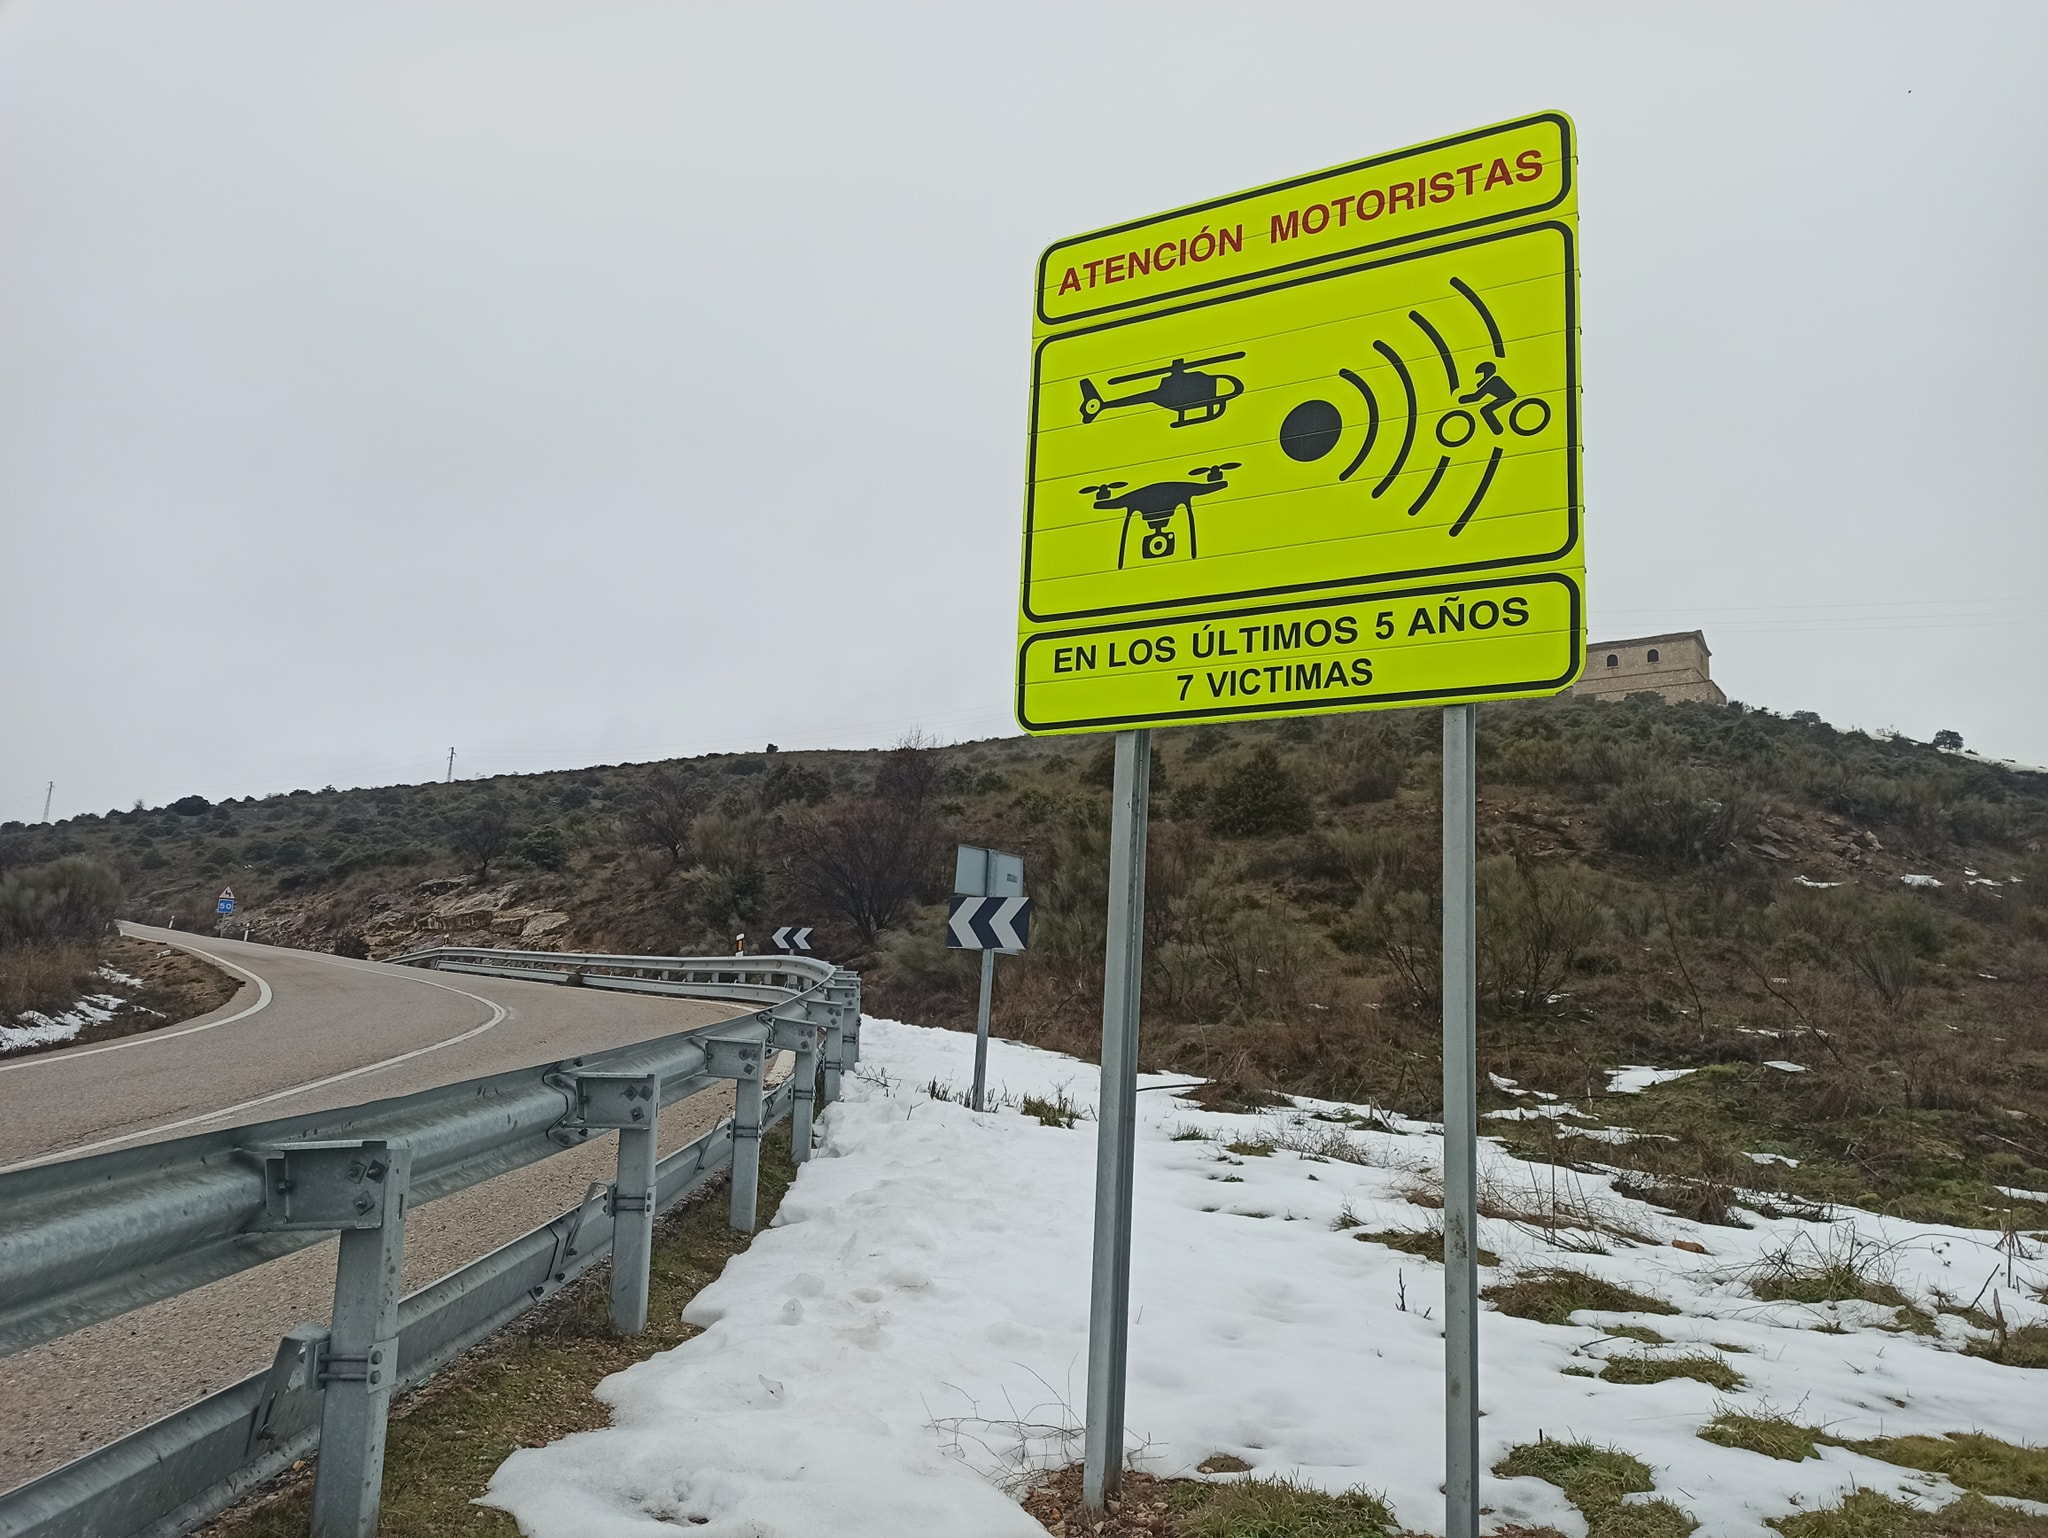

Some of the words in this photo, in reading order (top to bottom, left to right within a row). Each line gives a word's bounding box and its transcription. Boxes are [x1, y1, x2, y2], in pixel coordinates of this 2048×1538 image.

[1058, 224, 1243, 296] ATENCIÓN
[1270, 150, 1544, 244] MOTORISTAS
[1053, 644, 1097, 674] EN
[1109, 636, 1176, 667] LOS
[1192, 615, 1358, 658] ÚLTIMOS
[1375, 611, 1394, 640] 5
[1407, 596, 1530, 636] AÑOS
[1177, 674, 1193, 701] 7
[1207, 657, 1373, 697] VICTIMAS
